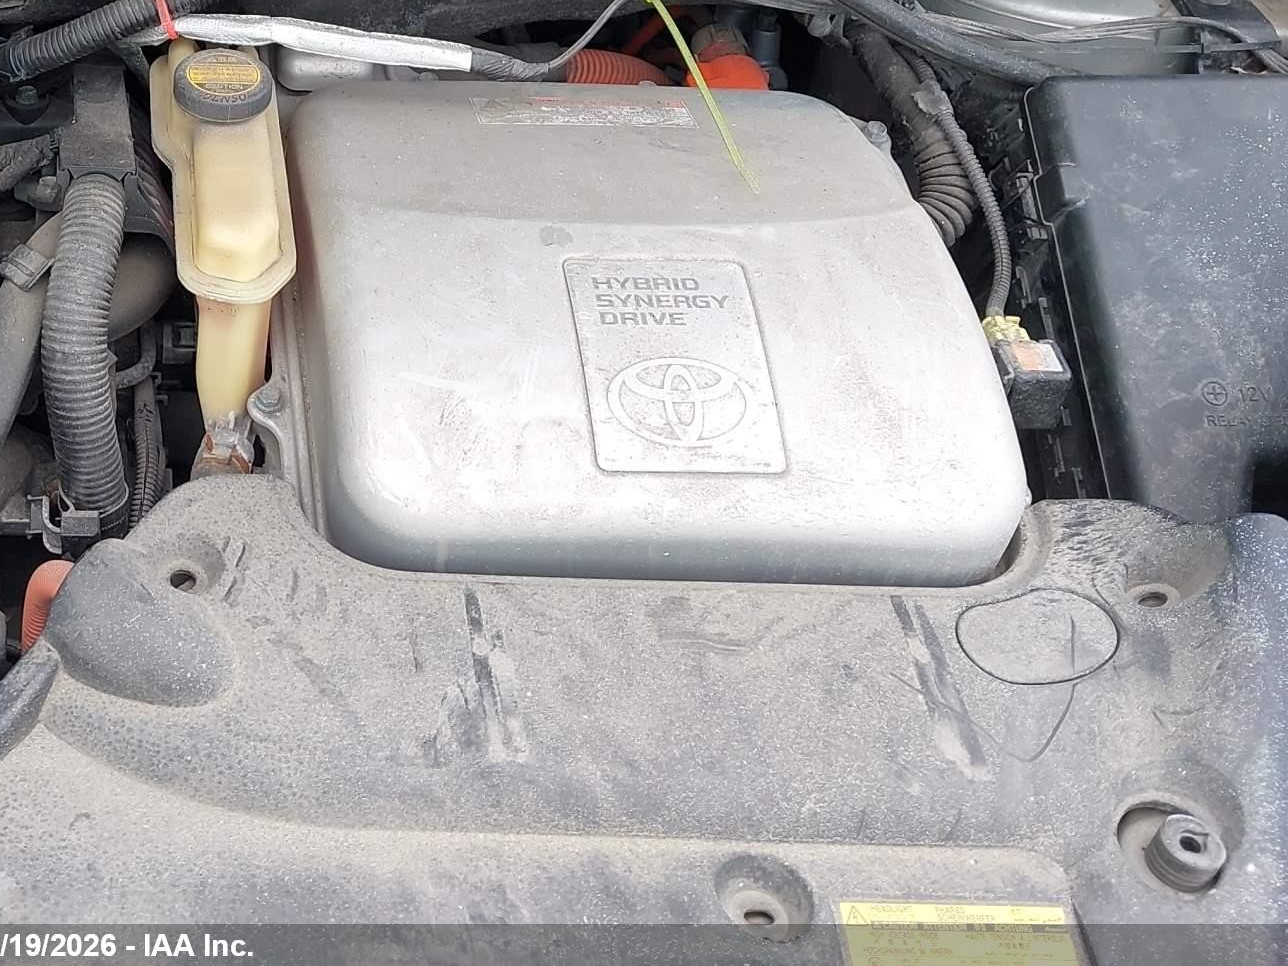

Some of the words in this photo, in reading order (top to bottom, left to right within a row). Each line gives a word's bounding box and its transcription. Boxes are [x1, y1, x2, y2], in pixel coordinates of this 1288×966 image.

[591, 277, 701, 291] HYBRID
[595, 294, 729, 309] SYNERGY
[599, 311, 688, 326] DRIVE
[1205, 414, 1253, 427] RELAY
